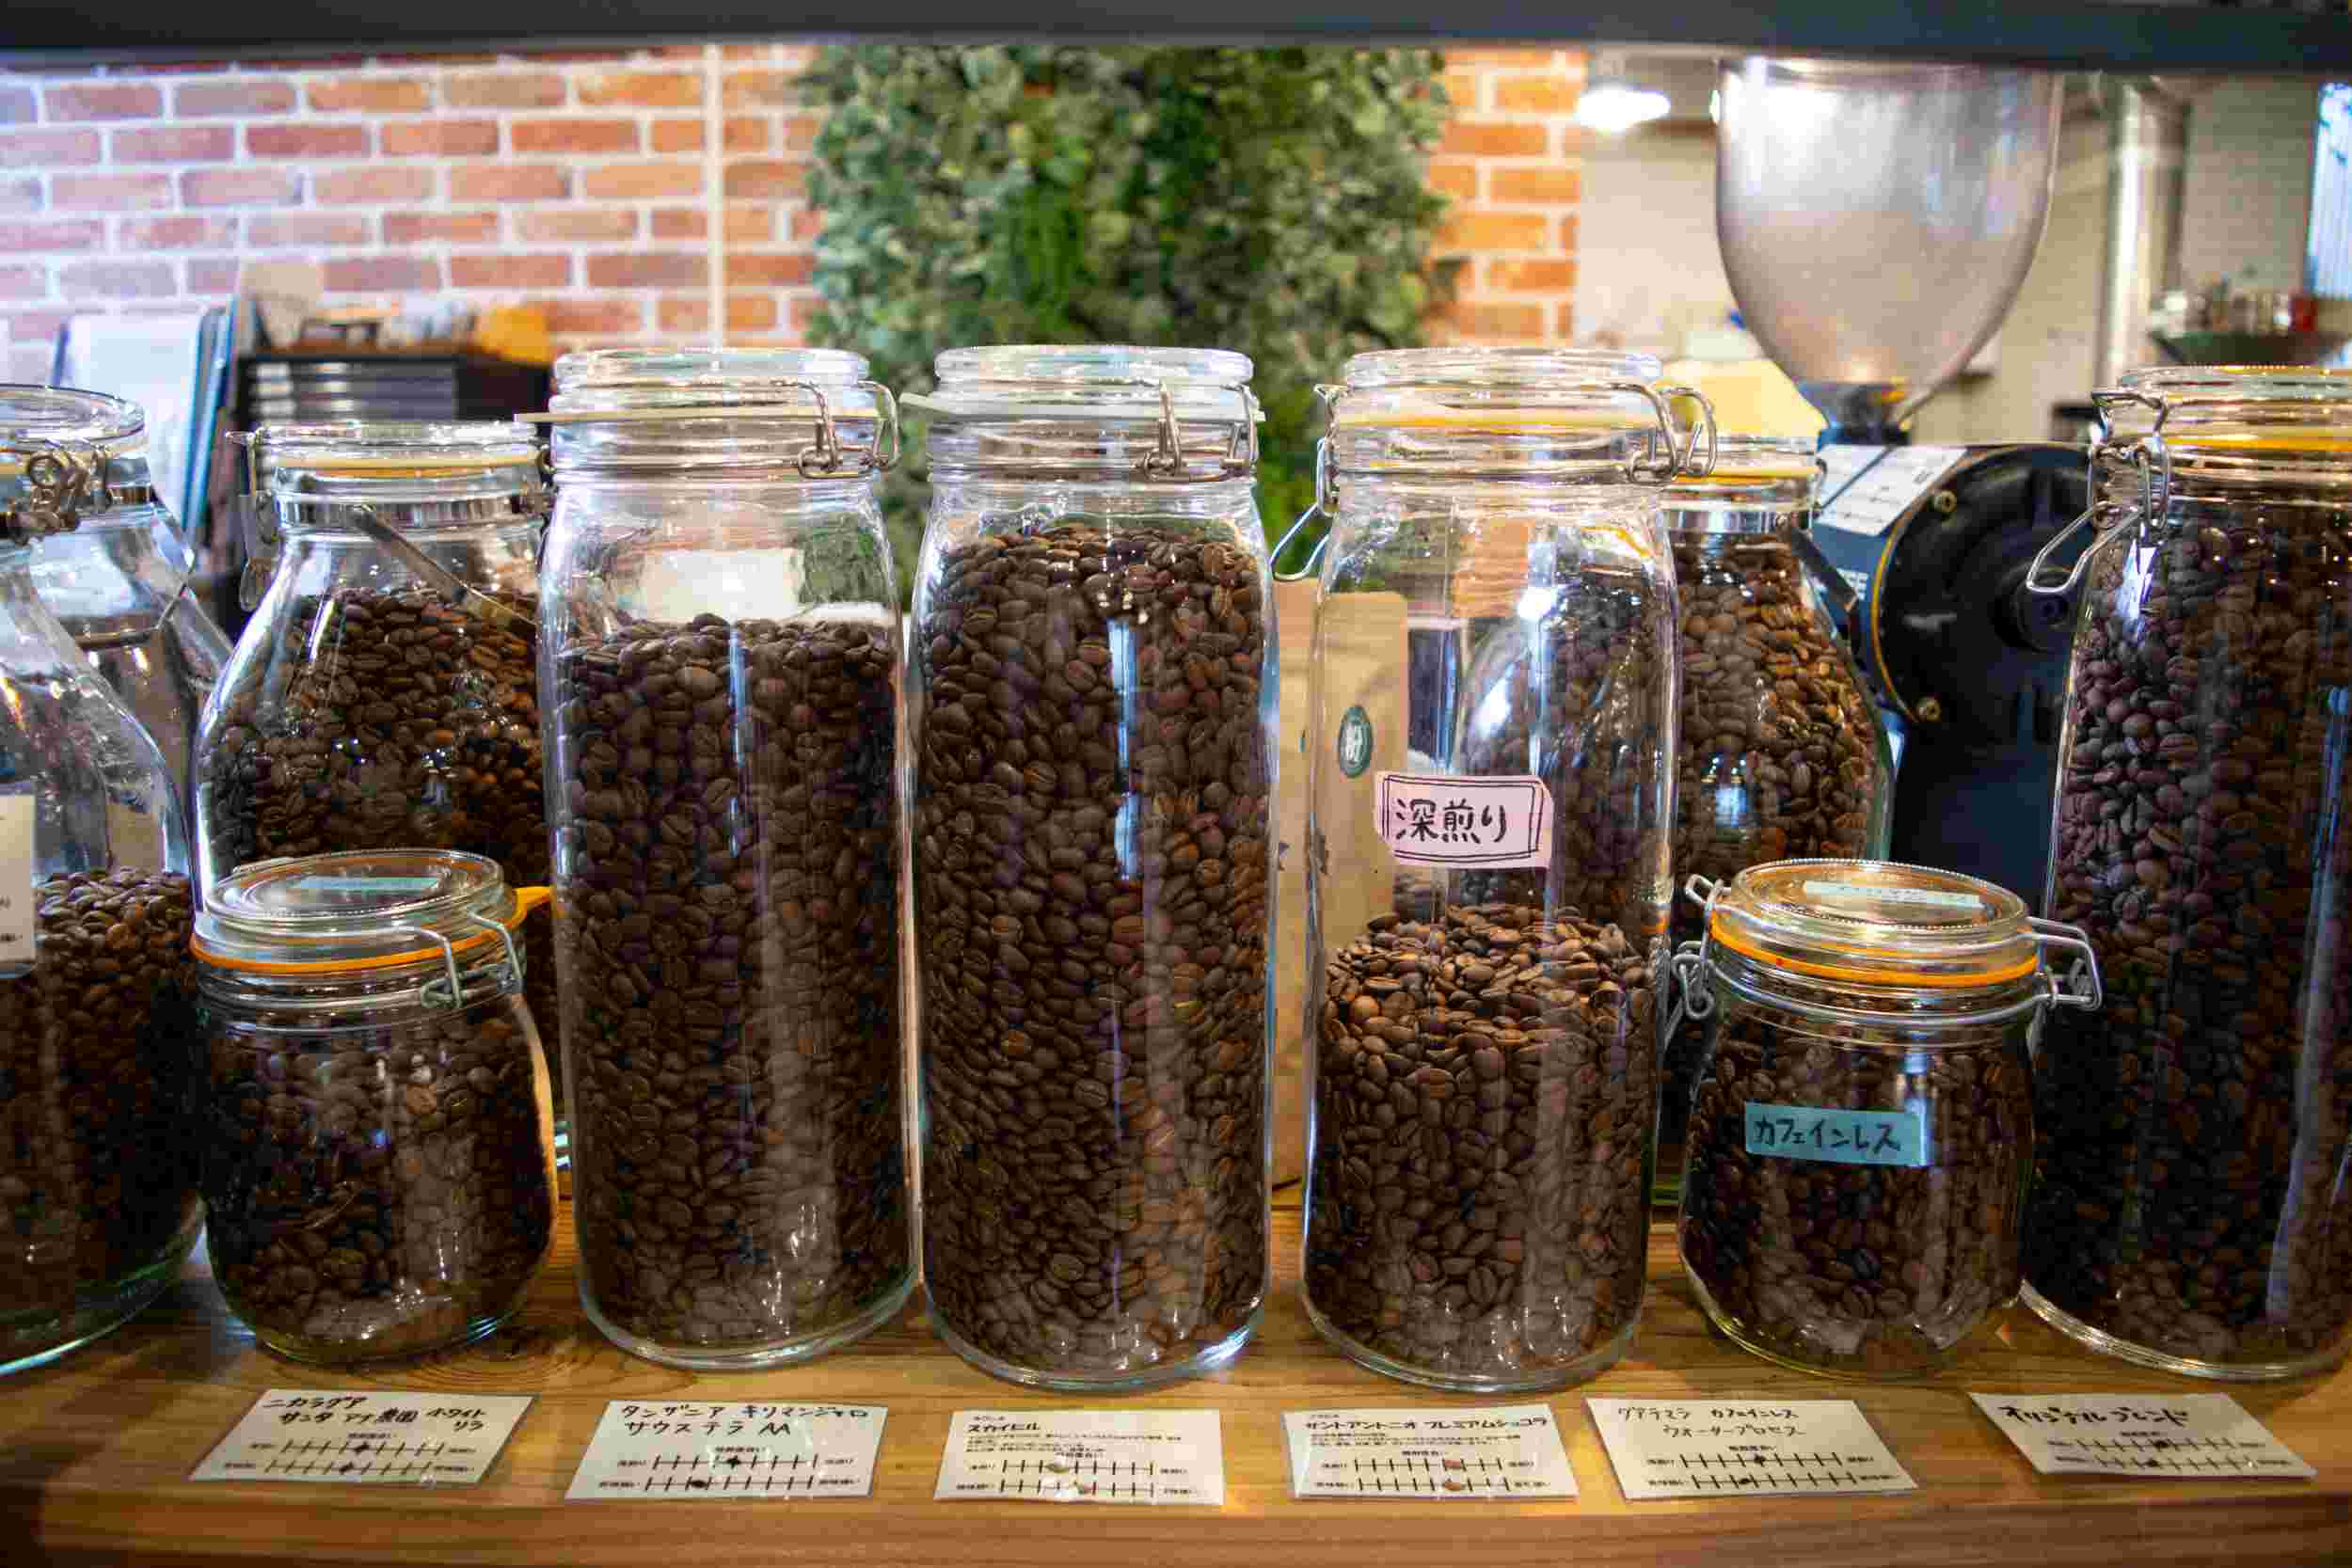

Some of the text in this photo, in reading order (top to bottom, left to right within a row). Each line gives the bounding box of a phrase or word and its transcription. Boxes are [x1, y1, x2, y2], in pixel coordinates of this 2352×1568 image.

[1395, 799, 1506, 845] 深煎り
[1754, 1117, 1901, 1154] カフェインレス
[621, 1403, 870, 1419] タンザニア キリマンジャロ
[1305, 1419, 1417, 1430] サントアントニオ
